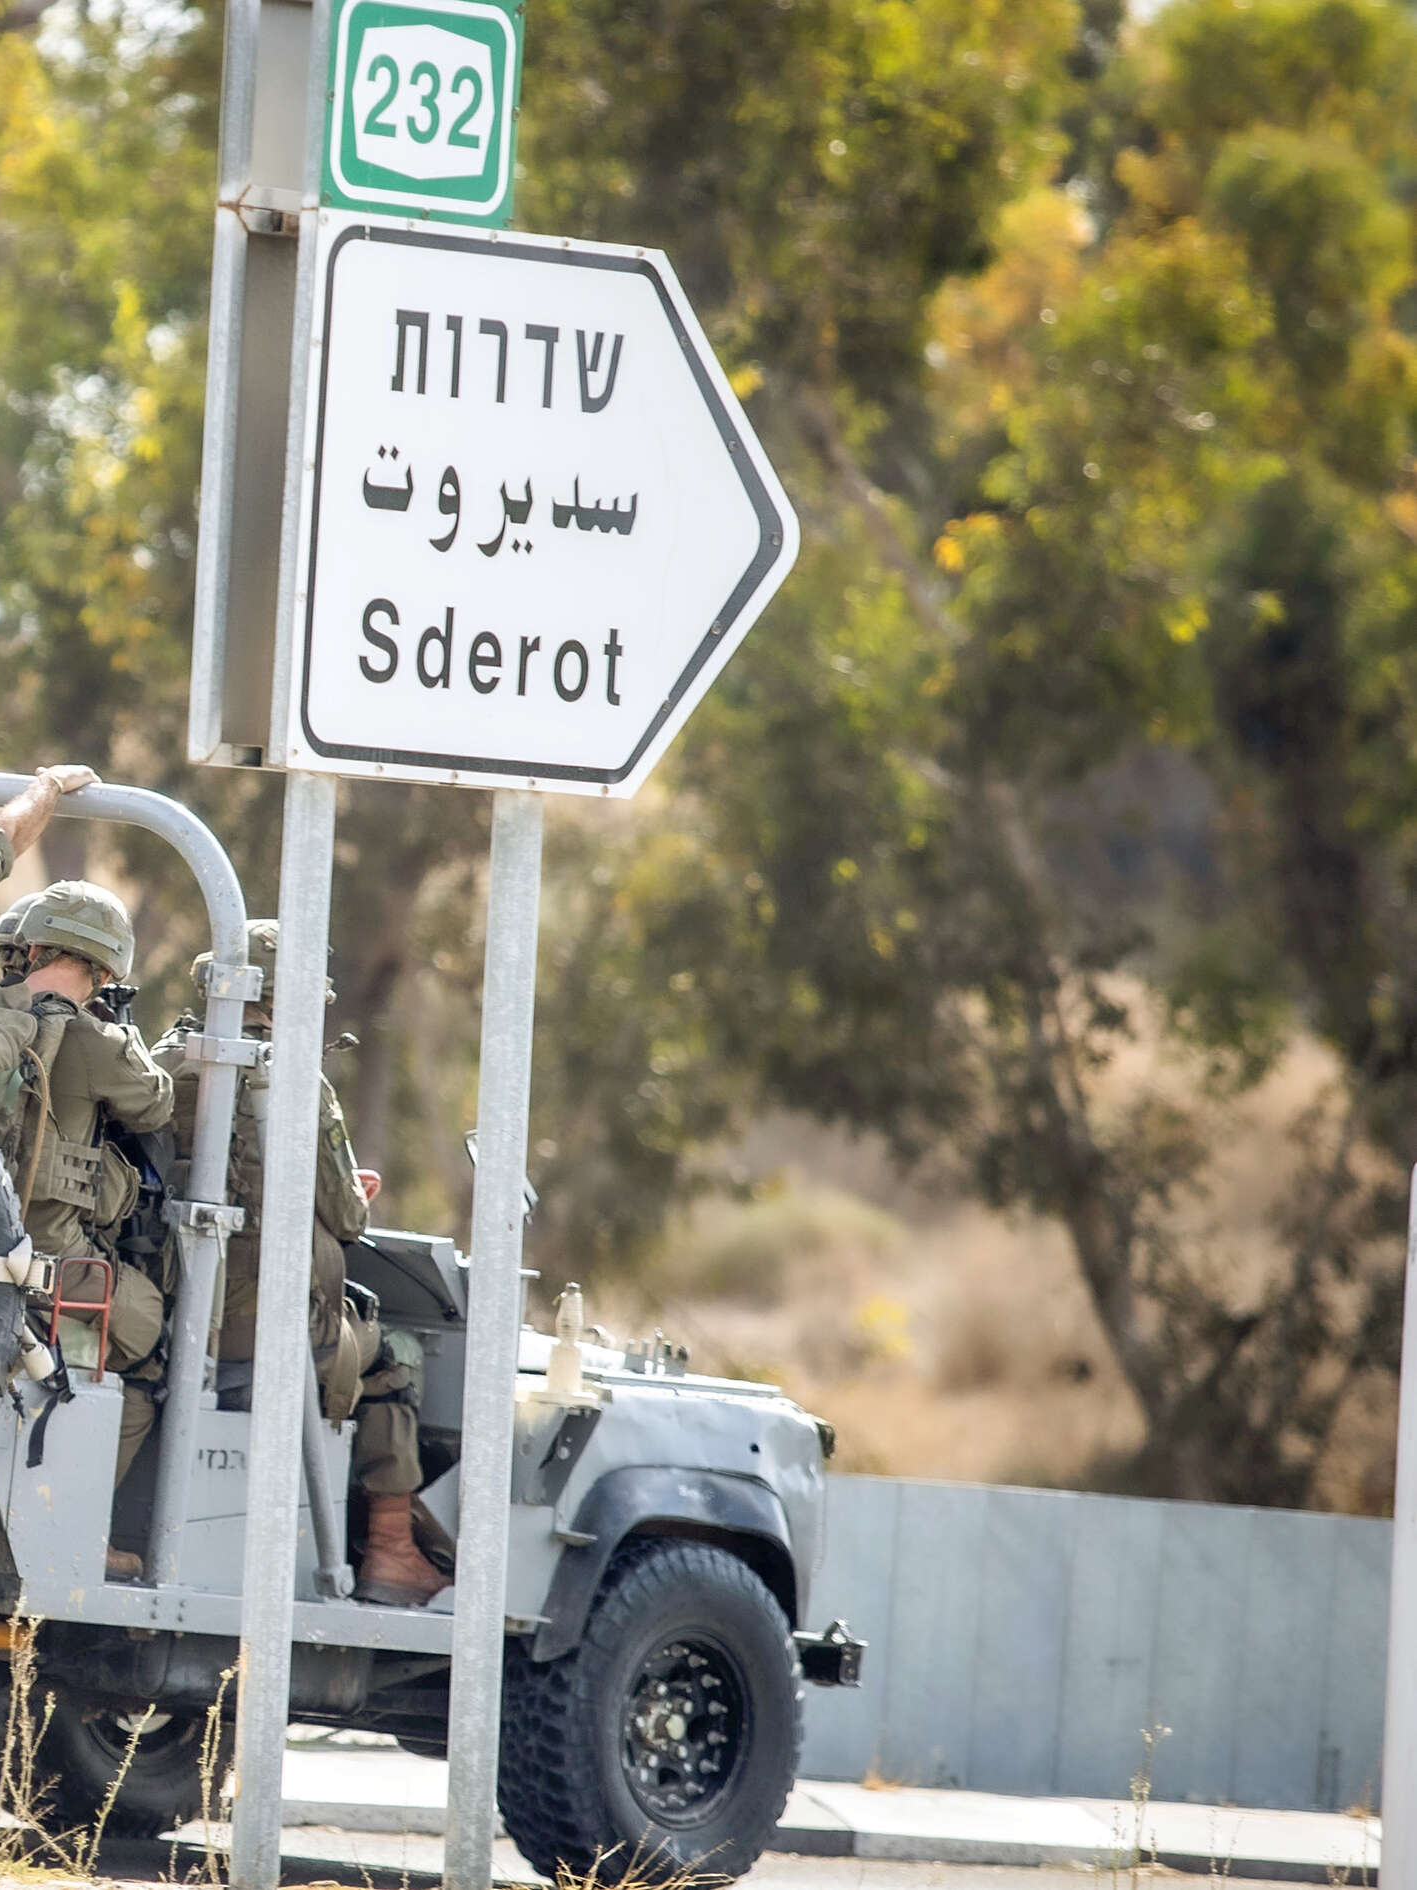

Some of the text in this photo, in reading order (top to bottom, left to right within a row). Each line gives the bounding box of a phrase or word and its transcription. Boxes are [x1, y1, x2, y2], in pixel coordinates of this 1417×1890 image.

[362, 54, 483, 149] 232
[391, 309, 624, 413] שדרות
[362, 445, 638, 557] سديروت
[358, 598, 623, 706] Sderot
